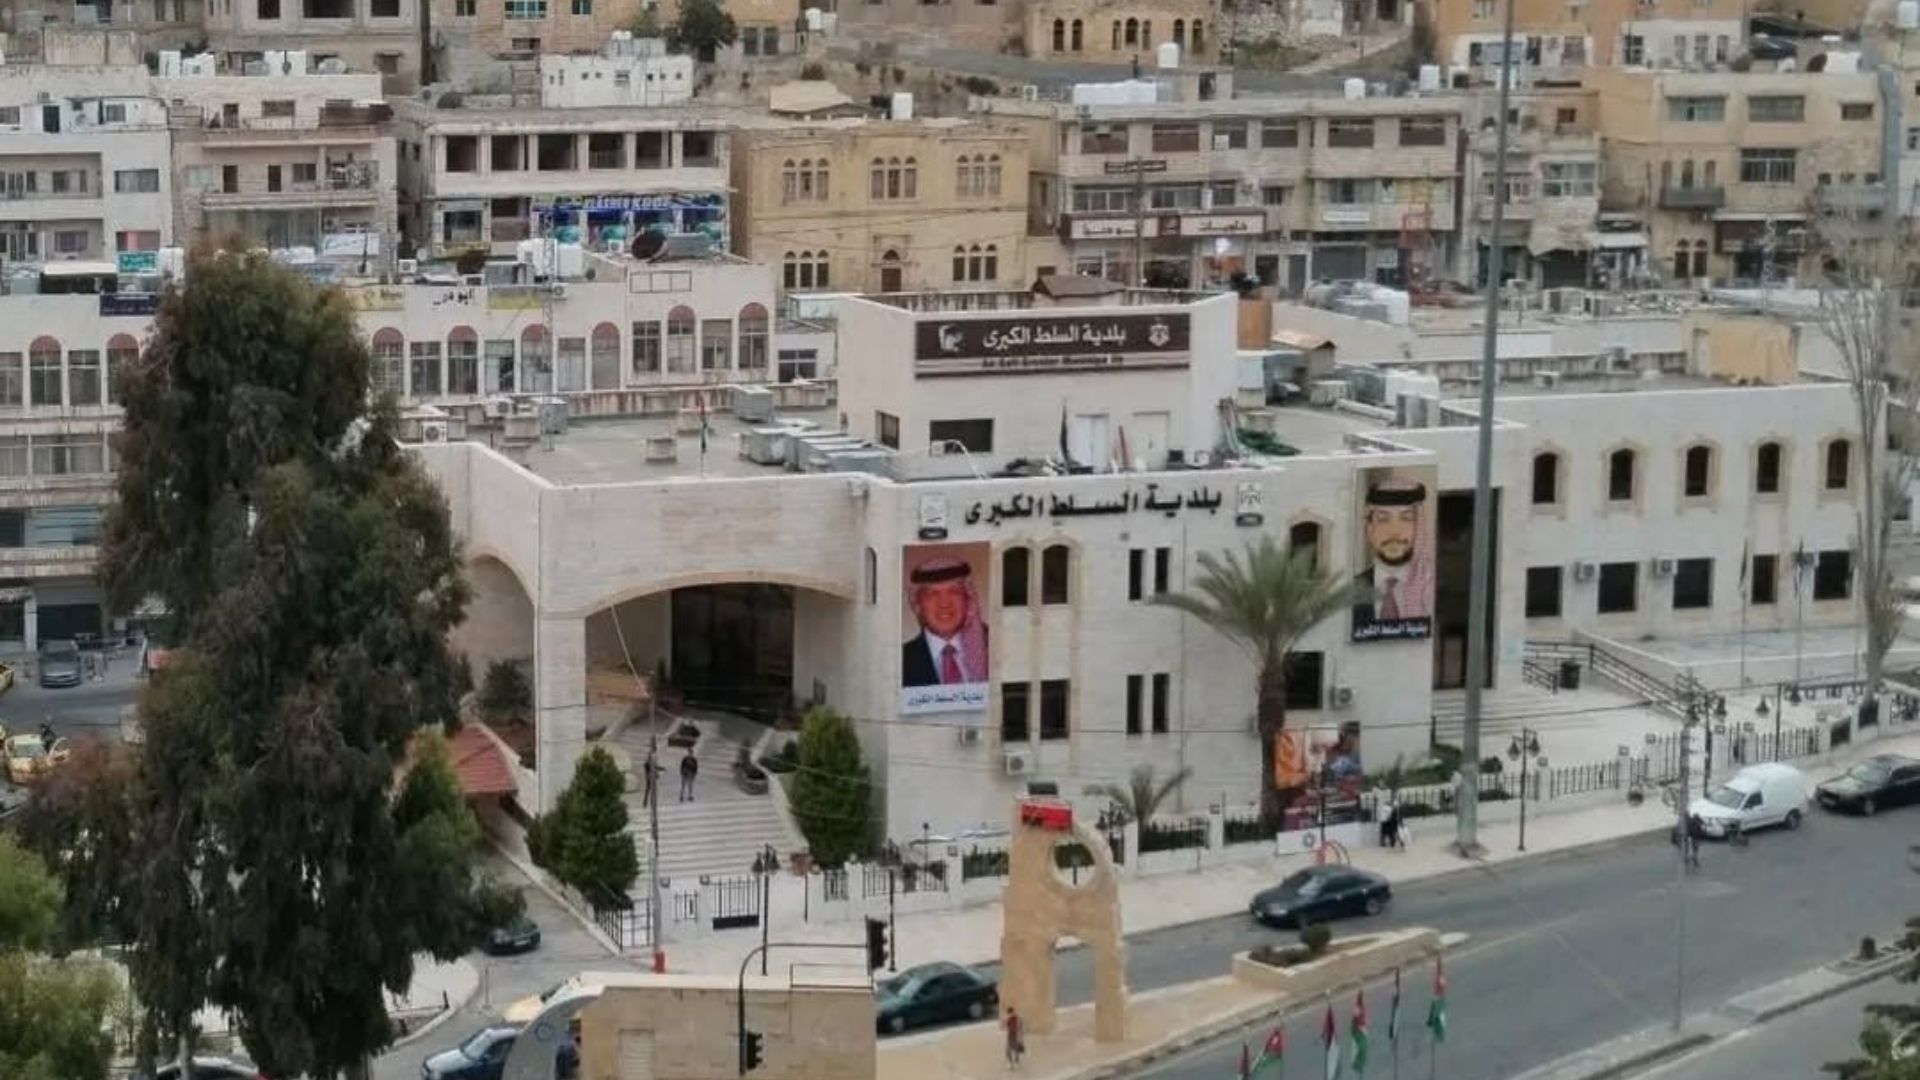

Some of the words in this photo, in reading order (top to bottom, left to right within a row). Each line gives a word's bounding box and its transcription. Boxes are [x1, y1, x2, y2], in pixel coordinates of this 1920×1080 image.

[982, 324, 1031, 350] الكبرى
[1034, 323, 1080, 344] السلط
[1083, 323, 1127, 347] بلدية
[964, 494, 1045, 527] الكبرى
[1049, 489, 1140, 517] السلط
[1145, 483, 1223, 517] بلدية
